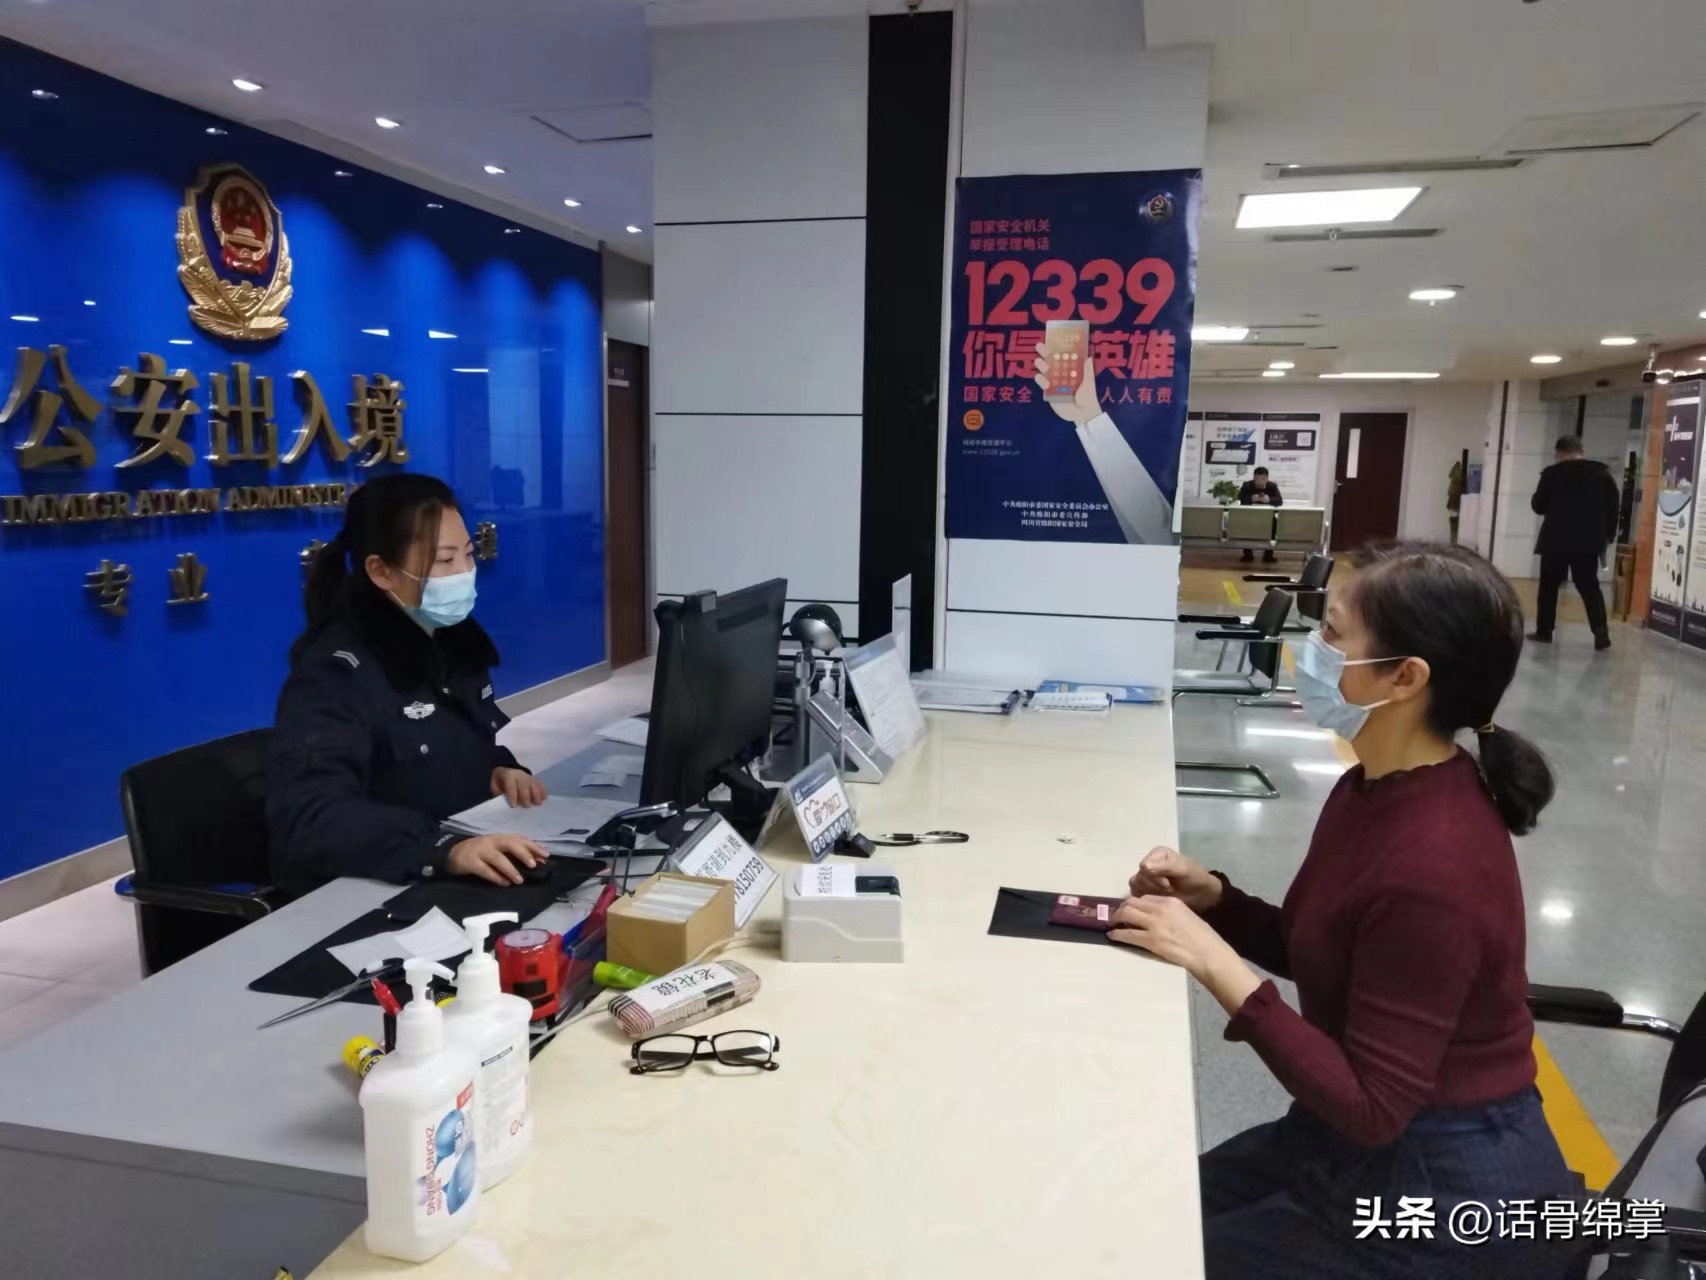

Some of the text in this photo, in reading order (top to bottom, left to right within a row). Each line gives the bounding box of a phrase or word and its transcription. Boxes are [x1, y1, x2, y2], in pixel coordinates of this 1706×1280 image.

[969, 237, 1049, 252] 举报受理电话
[970, 218, 1050, 235] 国家安全机关
[963, 257, 1176, 326] 12339
[1089, 329, 1176, 380] 英雄
[0, 344, 408, 469] 公安出入境
[963, 386, 1173, 404] 国家安全 人人有责
[1, 483, 357, 524] IMMIGRATION ADMINISTR
[734, 856, 764, 905] 8150759
